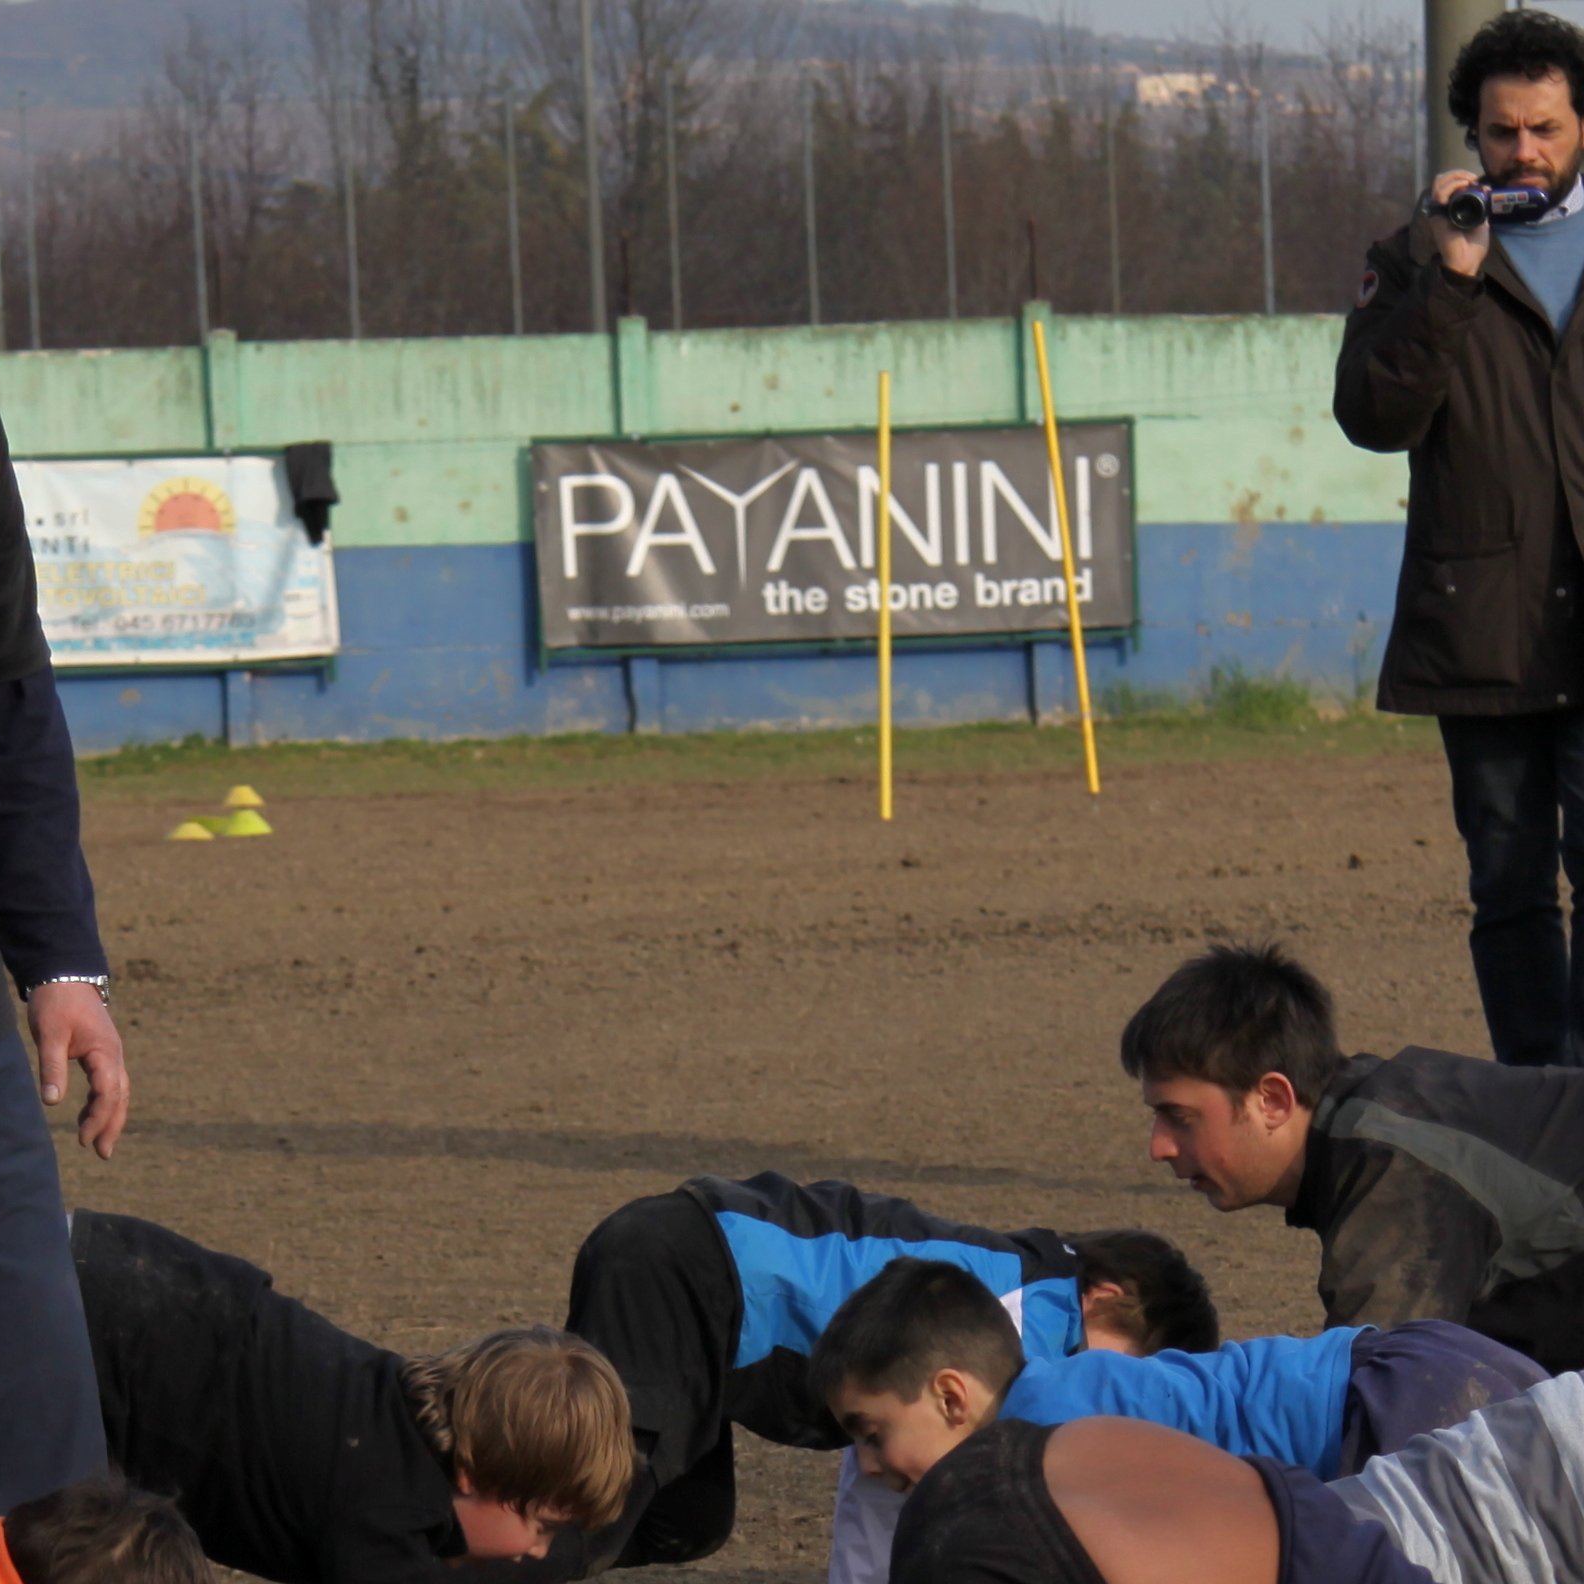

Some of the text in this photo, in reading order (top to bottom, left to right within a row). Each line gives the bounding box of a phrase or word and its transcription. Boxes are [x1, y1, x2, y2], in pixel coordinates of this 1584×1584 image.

[761, 568, 1094, 615] the stone brand
